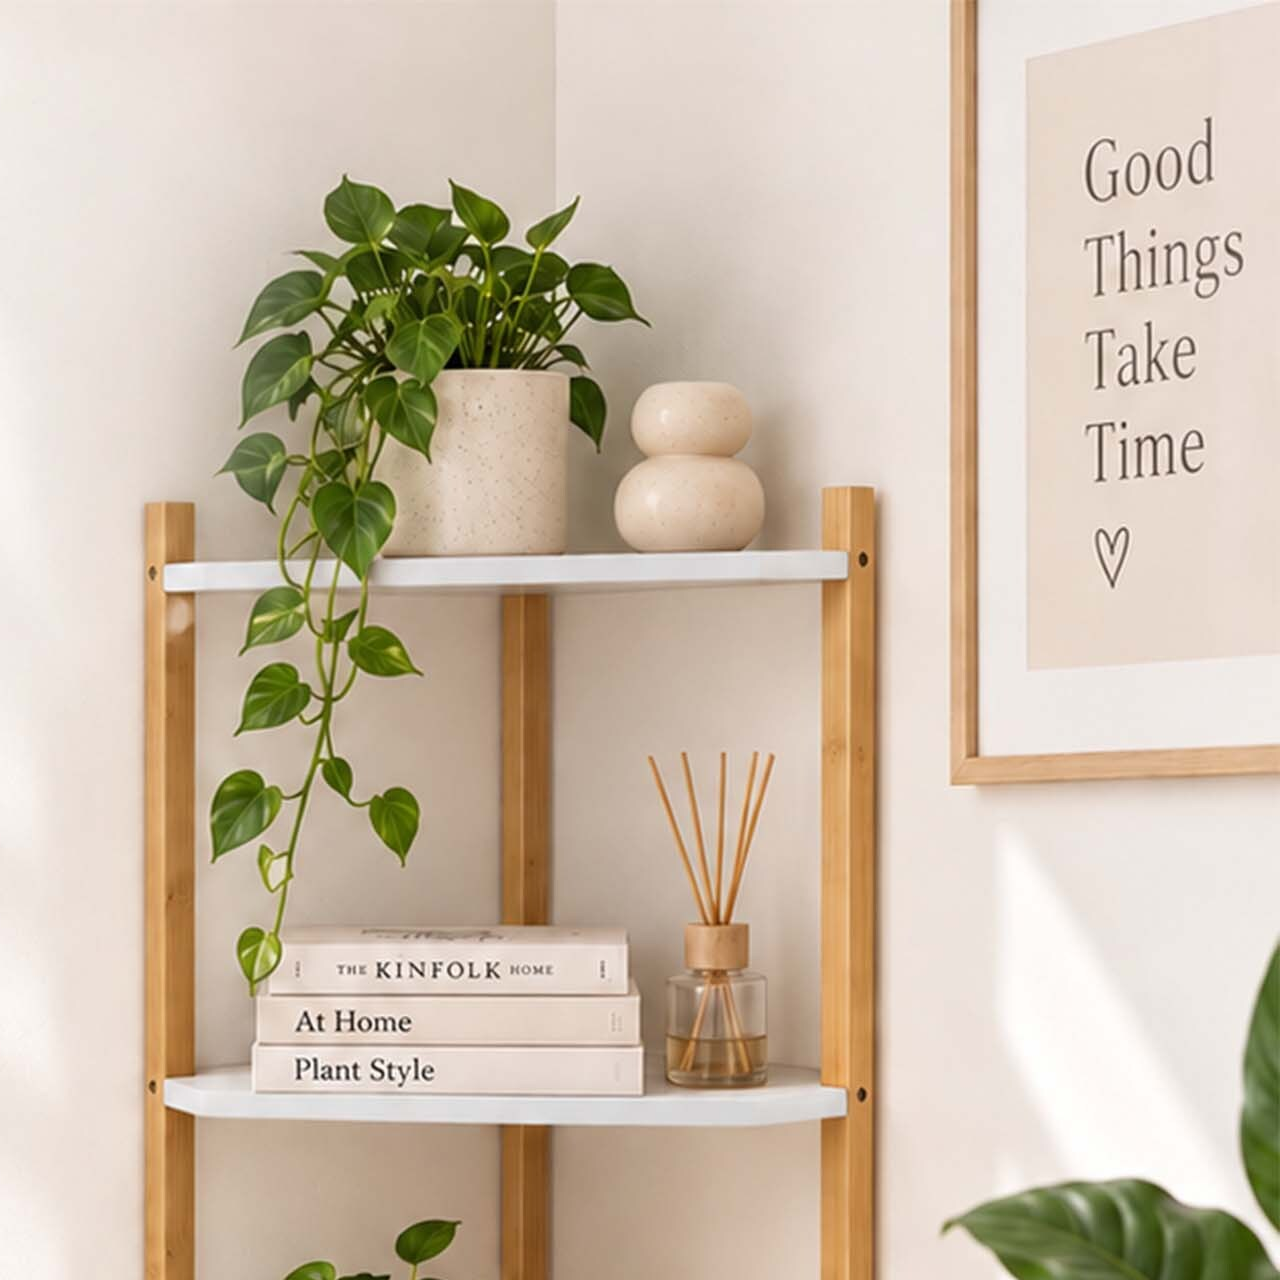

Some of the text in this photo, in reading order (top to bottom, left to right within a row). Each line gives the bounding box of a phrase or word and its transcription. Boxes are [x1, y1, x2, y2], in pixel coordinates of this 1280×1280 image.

[1084, 116, 1214, 203] Good
[1083, 228, 1244, 300] Things
[1084, 320, 1197, 391] Take
[1084, 420, 1205, 483] Time
[336, 960, 554, 981] THE KINFOLK HOME
[294, 1009, 413, 1034] At Home
[294, 1056, 436, 1089] Plant Style
